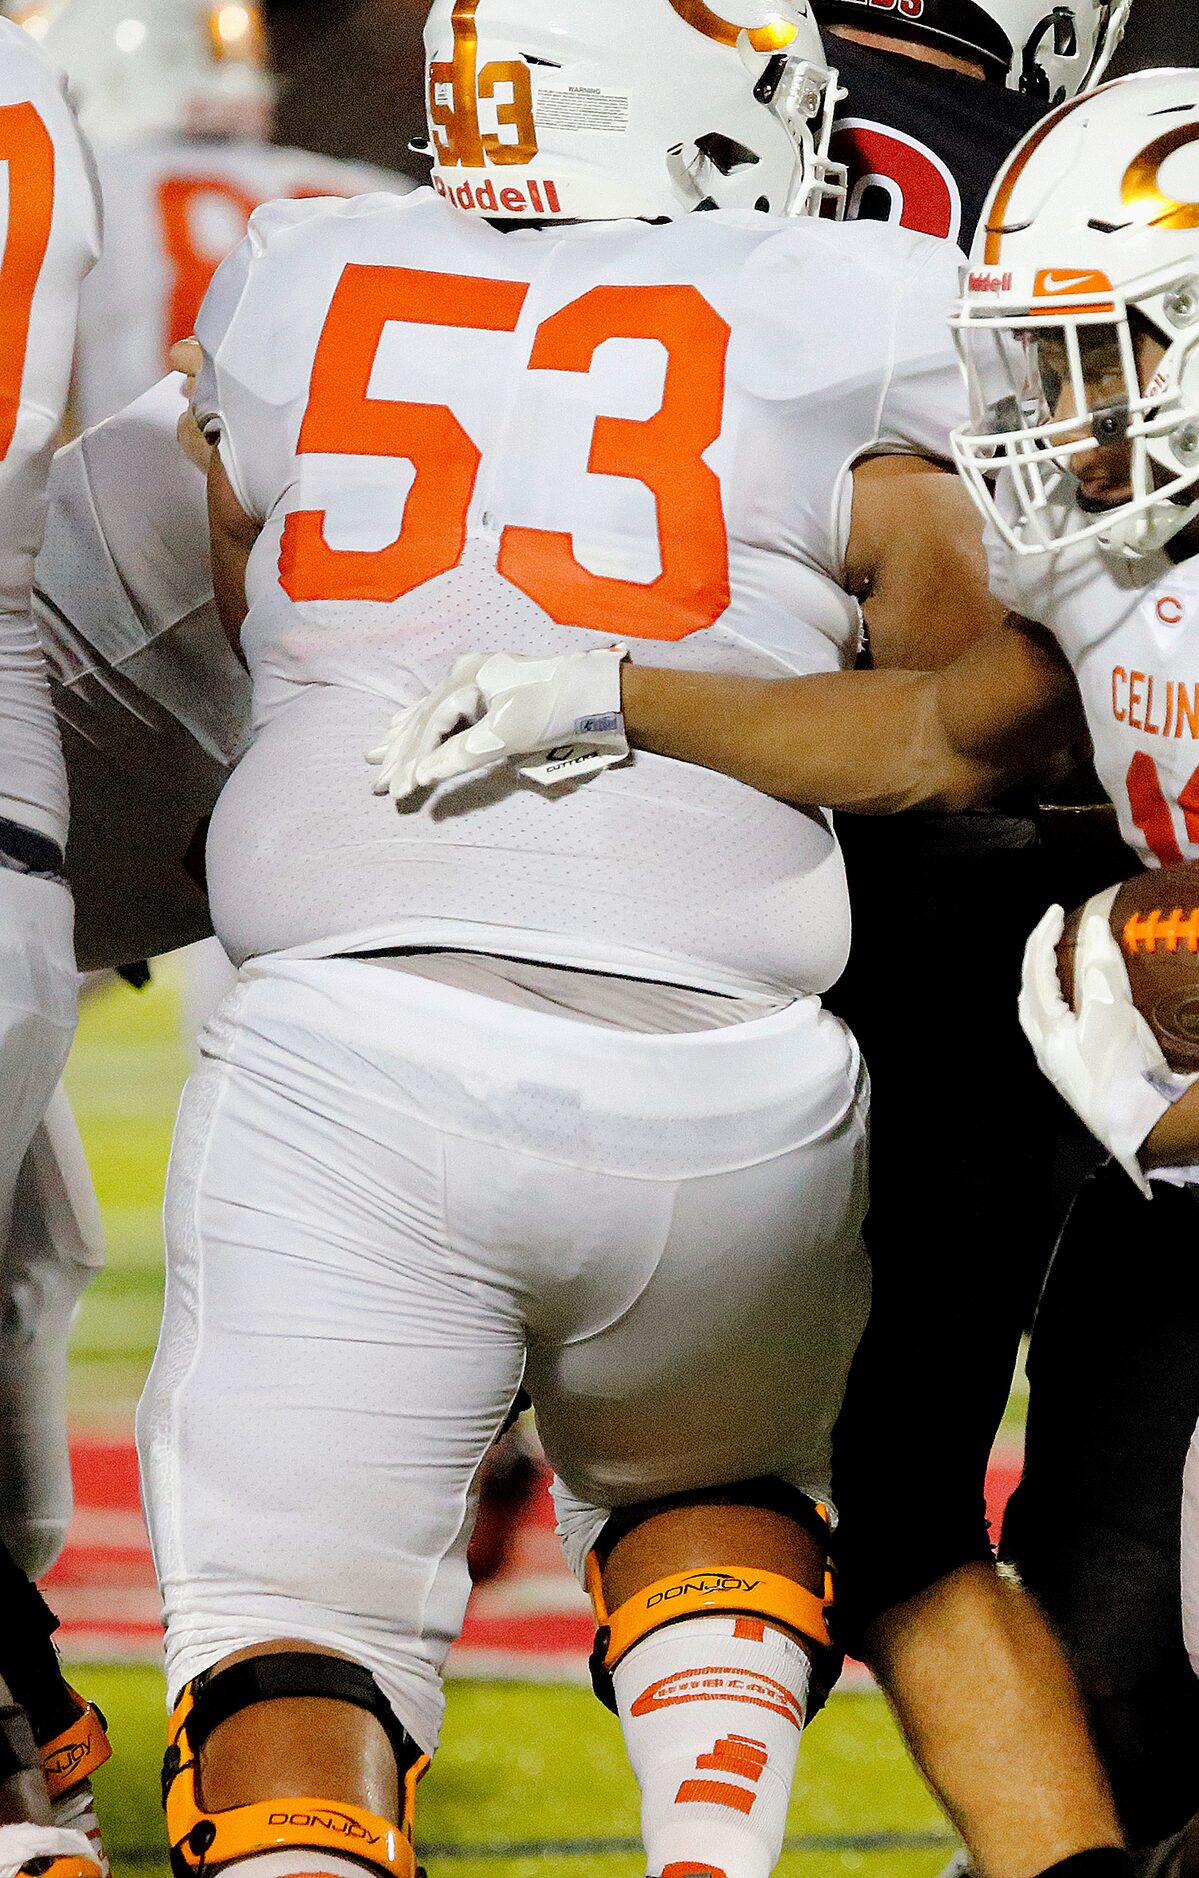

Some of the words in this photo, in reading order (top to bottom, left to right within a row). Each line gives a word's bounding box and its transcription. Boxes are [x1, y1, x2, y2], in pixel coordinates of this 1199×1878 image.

[277, 262, 732, 642] 53
[1157, 596, 1183, 624] C
[646, 1577, 761, 1609] DONJOY
[268, 1813, 381, 1845] DONJOY
